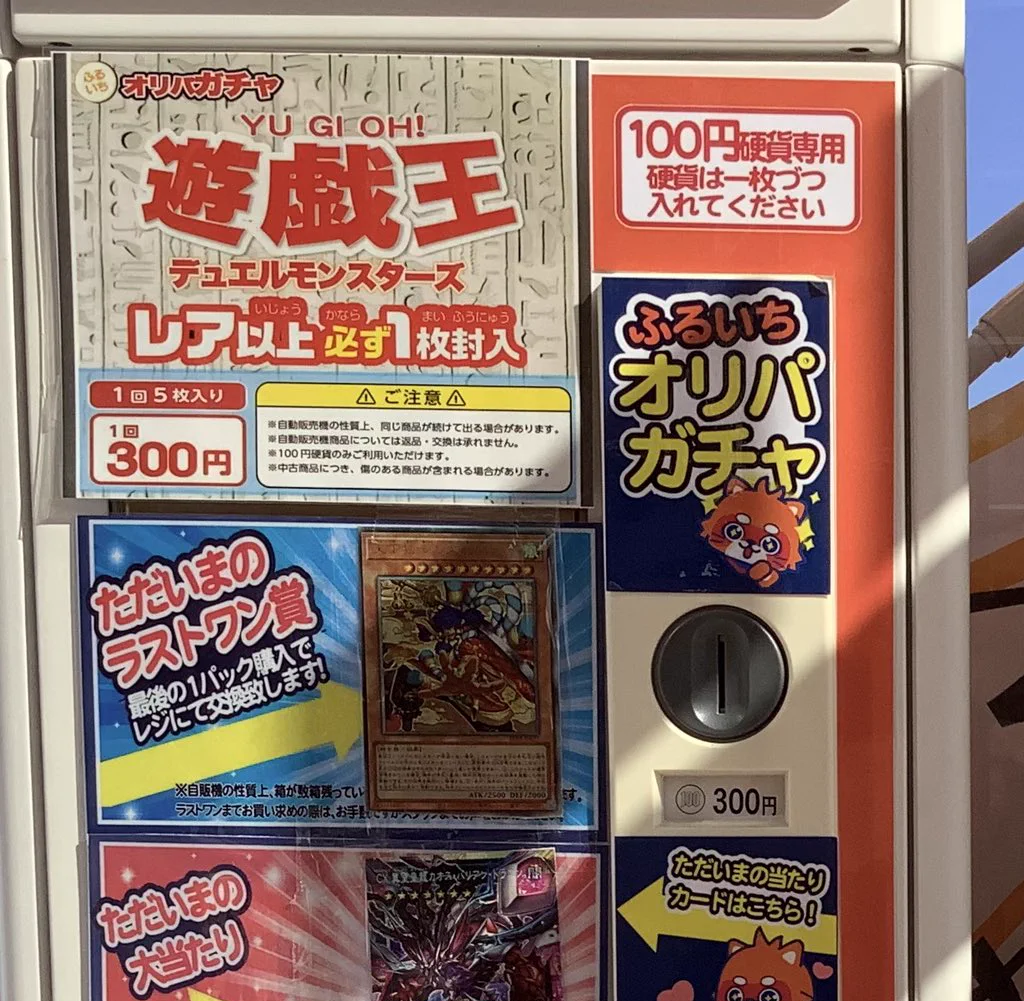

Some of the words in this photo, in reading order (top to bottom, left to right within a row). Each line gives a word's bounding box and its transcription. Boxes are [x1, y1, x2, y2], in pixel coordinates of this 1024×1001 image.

[241, 114, 292, 137] YU
[308, 116, 343, 138] GI
[359, 115, 426, 139] OH!
[629, 119, 845, 165] 100円硬貨専用
[142, 134, 518, 248] 遊戯王
[647, 165, 827, 191] 硬貨は一枚づつ
[647, 193, 826, 219] 入れてください
[169, 258, 466, 292] デュエルモンスターズ
[255, 303, 303, 317] いじょう
[325, 308, 362, 321] かなら
[421, 310, 446, 323] まい
[452, 311, 510, 324] ふうにゅう
[628, 299, 797, 347] ふるいち
[384, 389, 442, 407] ご注意
[616, 351, 820, 419] オリパ
[109, 424, 140, 439] 1回
[107, 441, 232, 478] 300円
[624, 420, 819, 496] ガチャ
[95, 540, 266, 631] ただいまの
[106, 577, 313, 684] ラストワン賞
[128, 639, 312, 719] 最後の1パック購入で
[712, 787, 777, 816] 300円
[674, 854, 825, 893] ただいまの当たり
[101, 874, 244, 943] ただいまの
[129, 923, 243, 991] 大当たり
